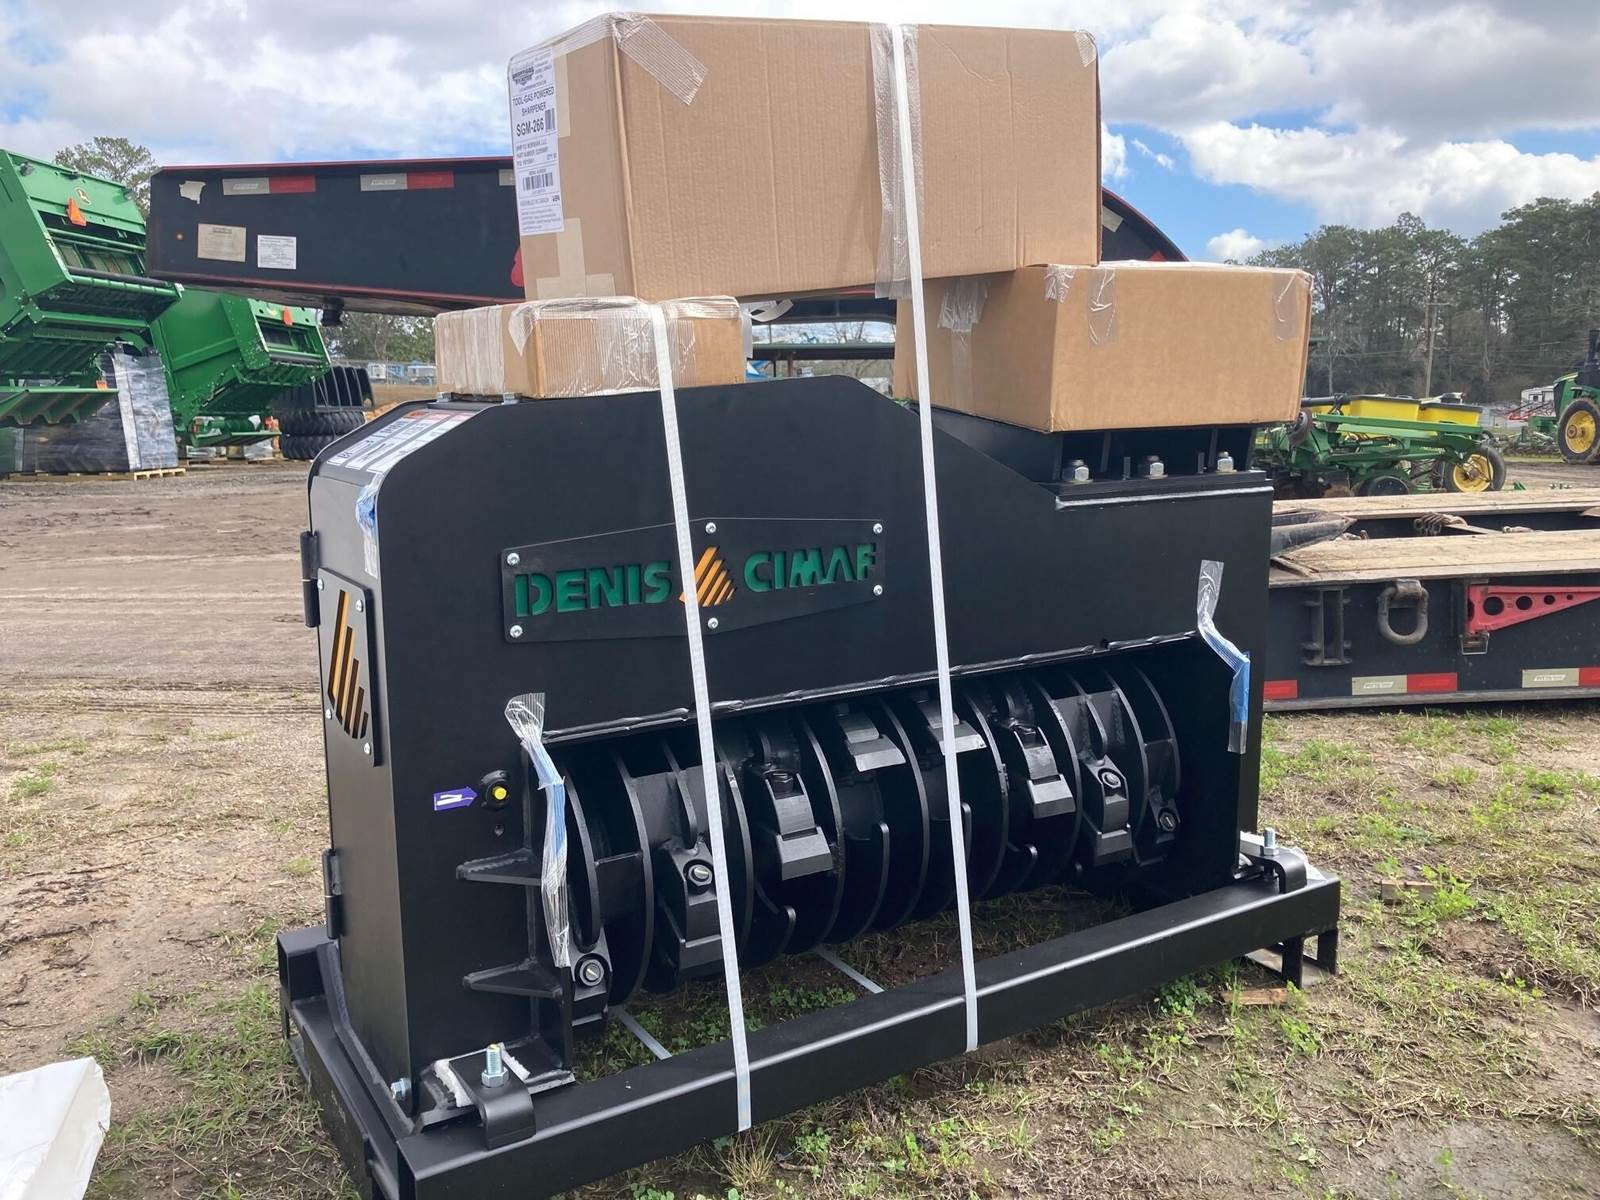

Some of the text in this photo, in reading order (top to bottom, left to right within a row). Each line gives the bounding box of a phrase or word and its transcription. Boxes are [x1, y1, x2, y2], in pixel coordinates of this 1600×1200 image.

[534, 86, 554, 99] POWERED
[522, 101, 547, 116] SHARPENER
[516, 118, 544, 136] SGM-266
[514, 542, 877, 618] DENIS CIMAF
